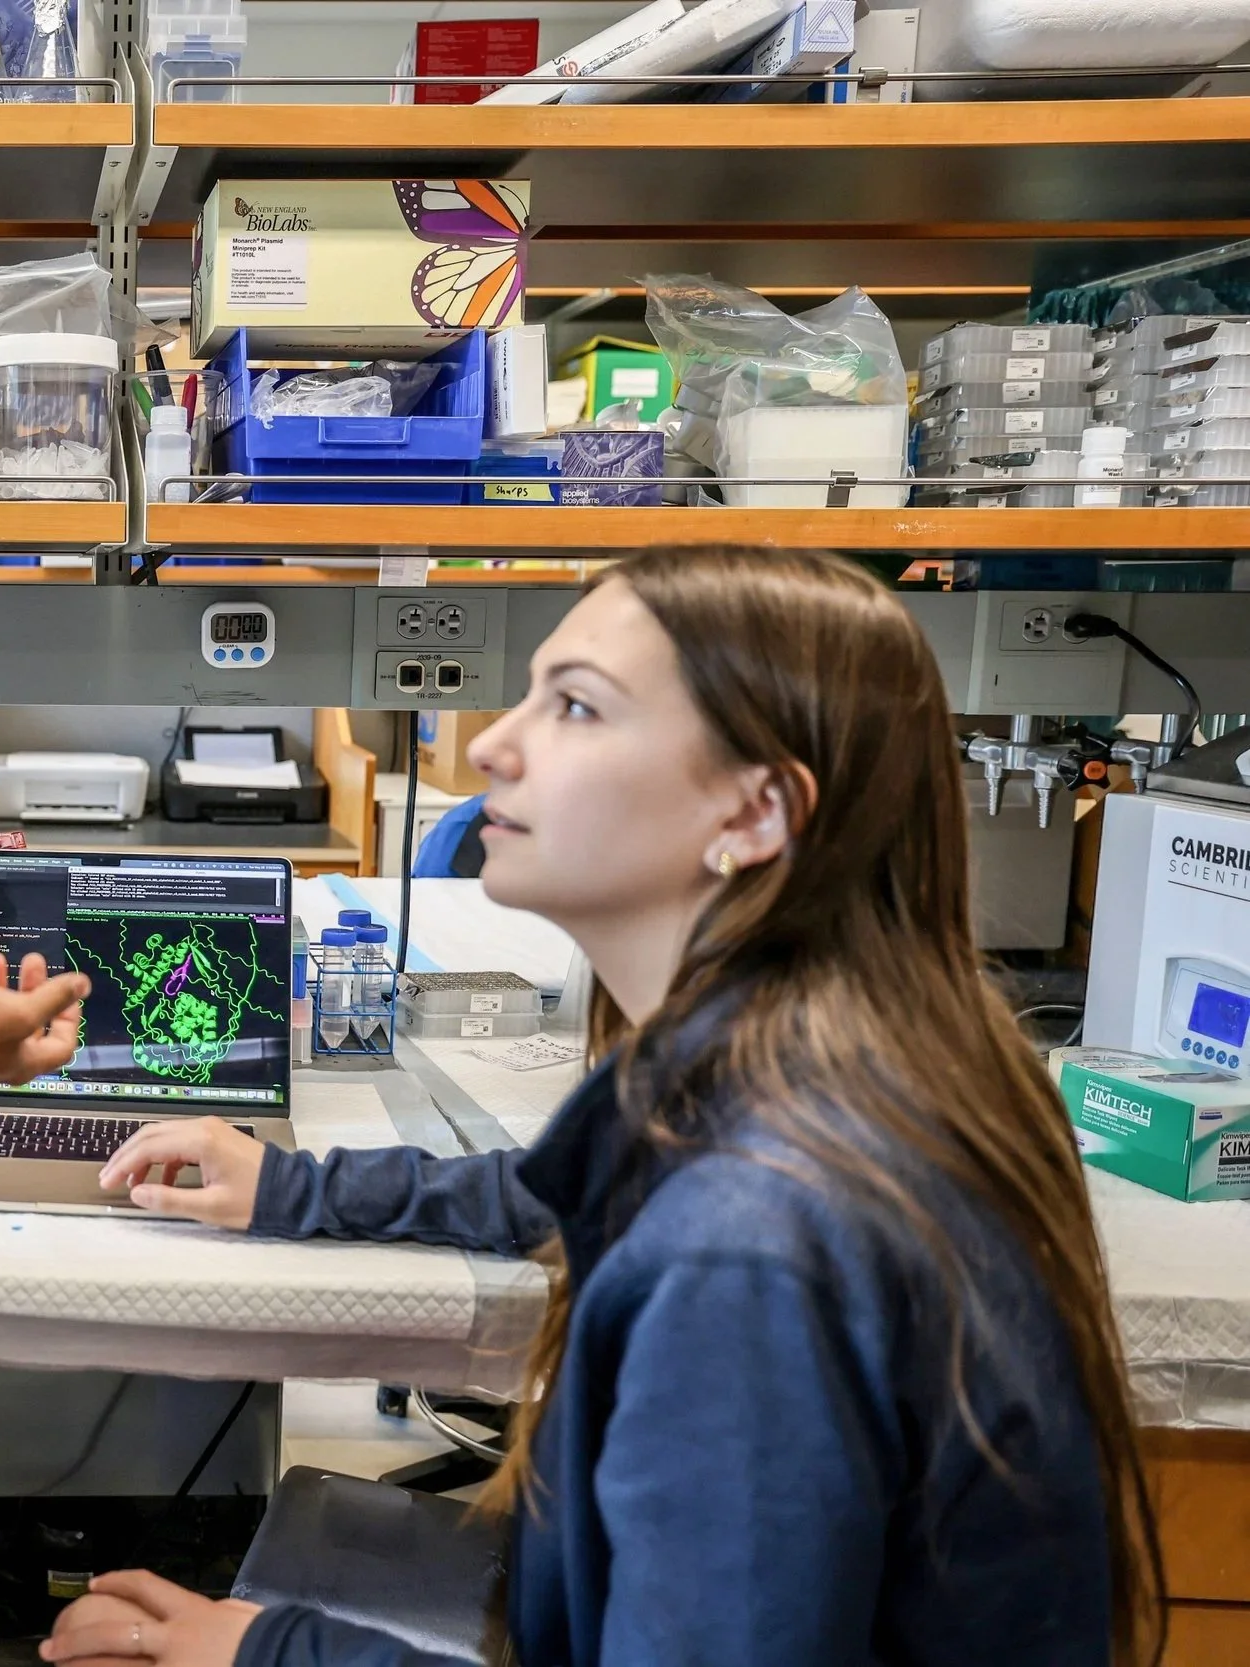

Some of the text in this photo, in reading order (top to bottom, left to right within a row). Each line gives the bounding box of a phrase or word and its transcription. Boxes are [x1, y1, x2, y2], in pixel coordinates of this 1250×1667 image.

[246, 213, 308, 231] BioLabs
[562, 490, 589, 498] applied
[1086, 1079, 1112, 1092] Kimwipes
[1085, 1086, 1152, 1120] KIMTECH
